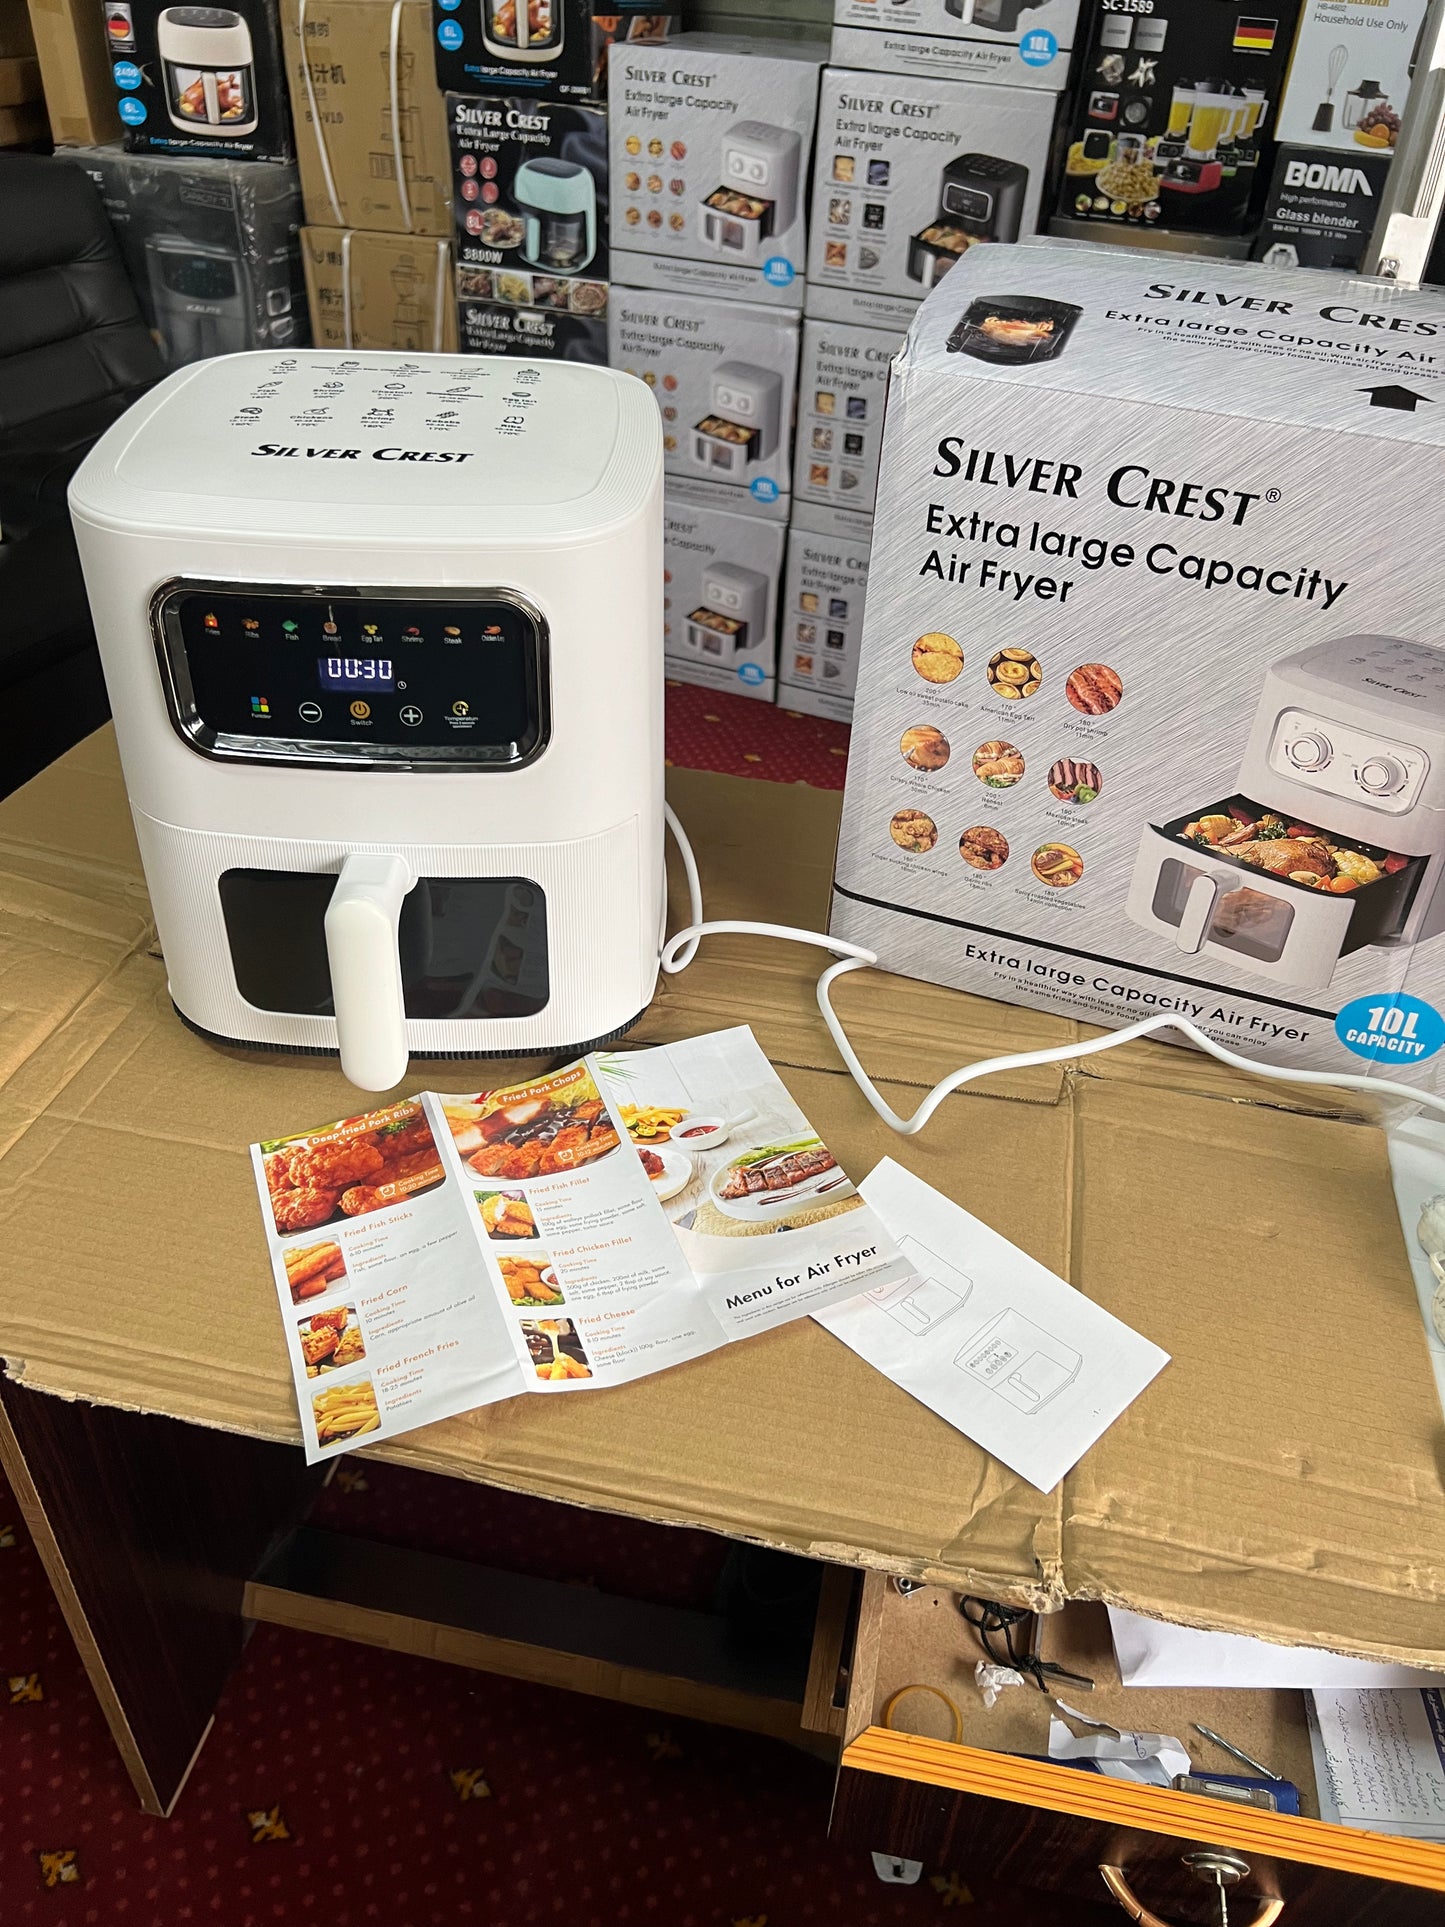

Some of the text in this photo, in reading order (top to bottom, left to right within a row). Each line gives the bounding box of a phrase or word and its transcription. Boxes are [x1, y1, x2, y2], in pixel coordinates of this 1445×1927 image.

[1314, 13, 1408, 33] Household Use Only
[884, 40, 906, 51] Extra
[907, 43, 930, 55] large
[932, 46, 973, 60] Capacity
[625, 66, 713, 88] SILVER CREST
[625, 89, 739, 113] Extra large Capacity
[838, 94, 935, 119] SILVER CREST
[456, 104, 551, 130] SILVER CREST
[625, 106, 669, 122] Air Fryer
[456, 125, 551, 145] Extra Large Capacity
[835, 118, 962, 146] Extra large Capacity
[835, 136, 883, 152] Air Fryer
[458, 139, 500, 153] Air Fryer
[1284, 161, 1373, 196] BOMA
[1280, 192, 1347, 208] High performance
[1276, 207, 1359, 228] Glass blender
[1143, 283, 1445, 336] SILVER CRES
[1105, 310, 1437, 364] Extra large Capacity Air
[1174, 332, 1216, 342] healthier
[1371, 359, 1395, 368] fryer
[251, 444, 475, 463] SILVER CREST
[932, 436, 1083, 500] SILVER
[925, 503, 1349, 611] Extra large Capacity
[918, 549, 1075, 603] Air Fryer
[361, 635, 373, 644] Egg
[328, 658, 392, 680] 00:30
[1362, 677, 1392, 691] SILVER
[965, 943, 1311, 1043] Extra large Capacity Air Fryer
[994, 971, 1007, 980] Fry
[1024, 979, 1060, 993] healthier
[1062, 989, 1078, 999] way
[1079, 993, 1096, 1003] with
[1098, 999, 1115, 1008] less
[1208, 1026, 1225, 1036] you
[1225, 1031, 1242, 1040] can
[1243, 1035, 1268, 1047] enjoy
[1015, 984, 1240, 1046] the same fried and crispy foods grease
[1367, 1005, 1419, 1039] 10L
[1345, 1028, 1426, 1056] CAPACITY
[502, 1070, 582, 1104] Fried Pork Chops
[311, 1106, 415, 1145] Deep-fried Pork Ribs
[398, 1168, 439, 1187] Cooking Time
[529, 1177, 590, 1195] Fried Fish Fillet
[343, 1211, 413, 1239] Fried Fish Sticks
[552, 1236, 633, 1258] Fried Chicken Fillet
[726, 1245, 878, 1309] Menu for Air Fryer
[360, 1284, 409, 1308] Fried Corn
[578, 1308, 636, 1326] Fried Cheese
[376, 1340, 460, 1376] Fried French Fries
